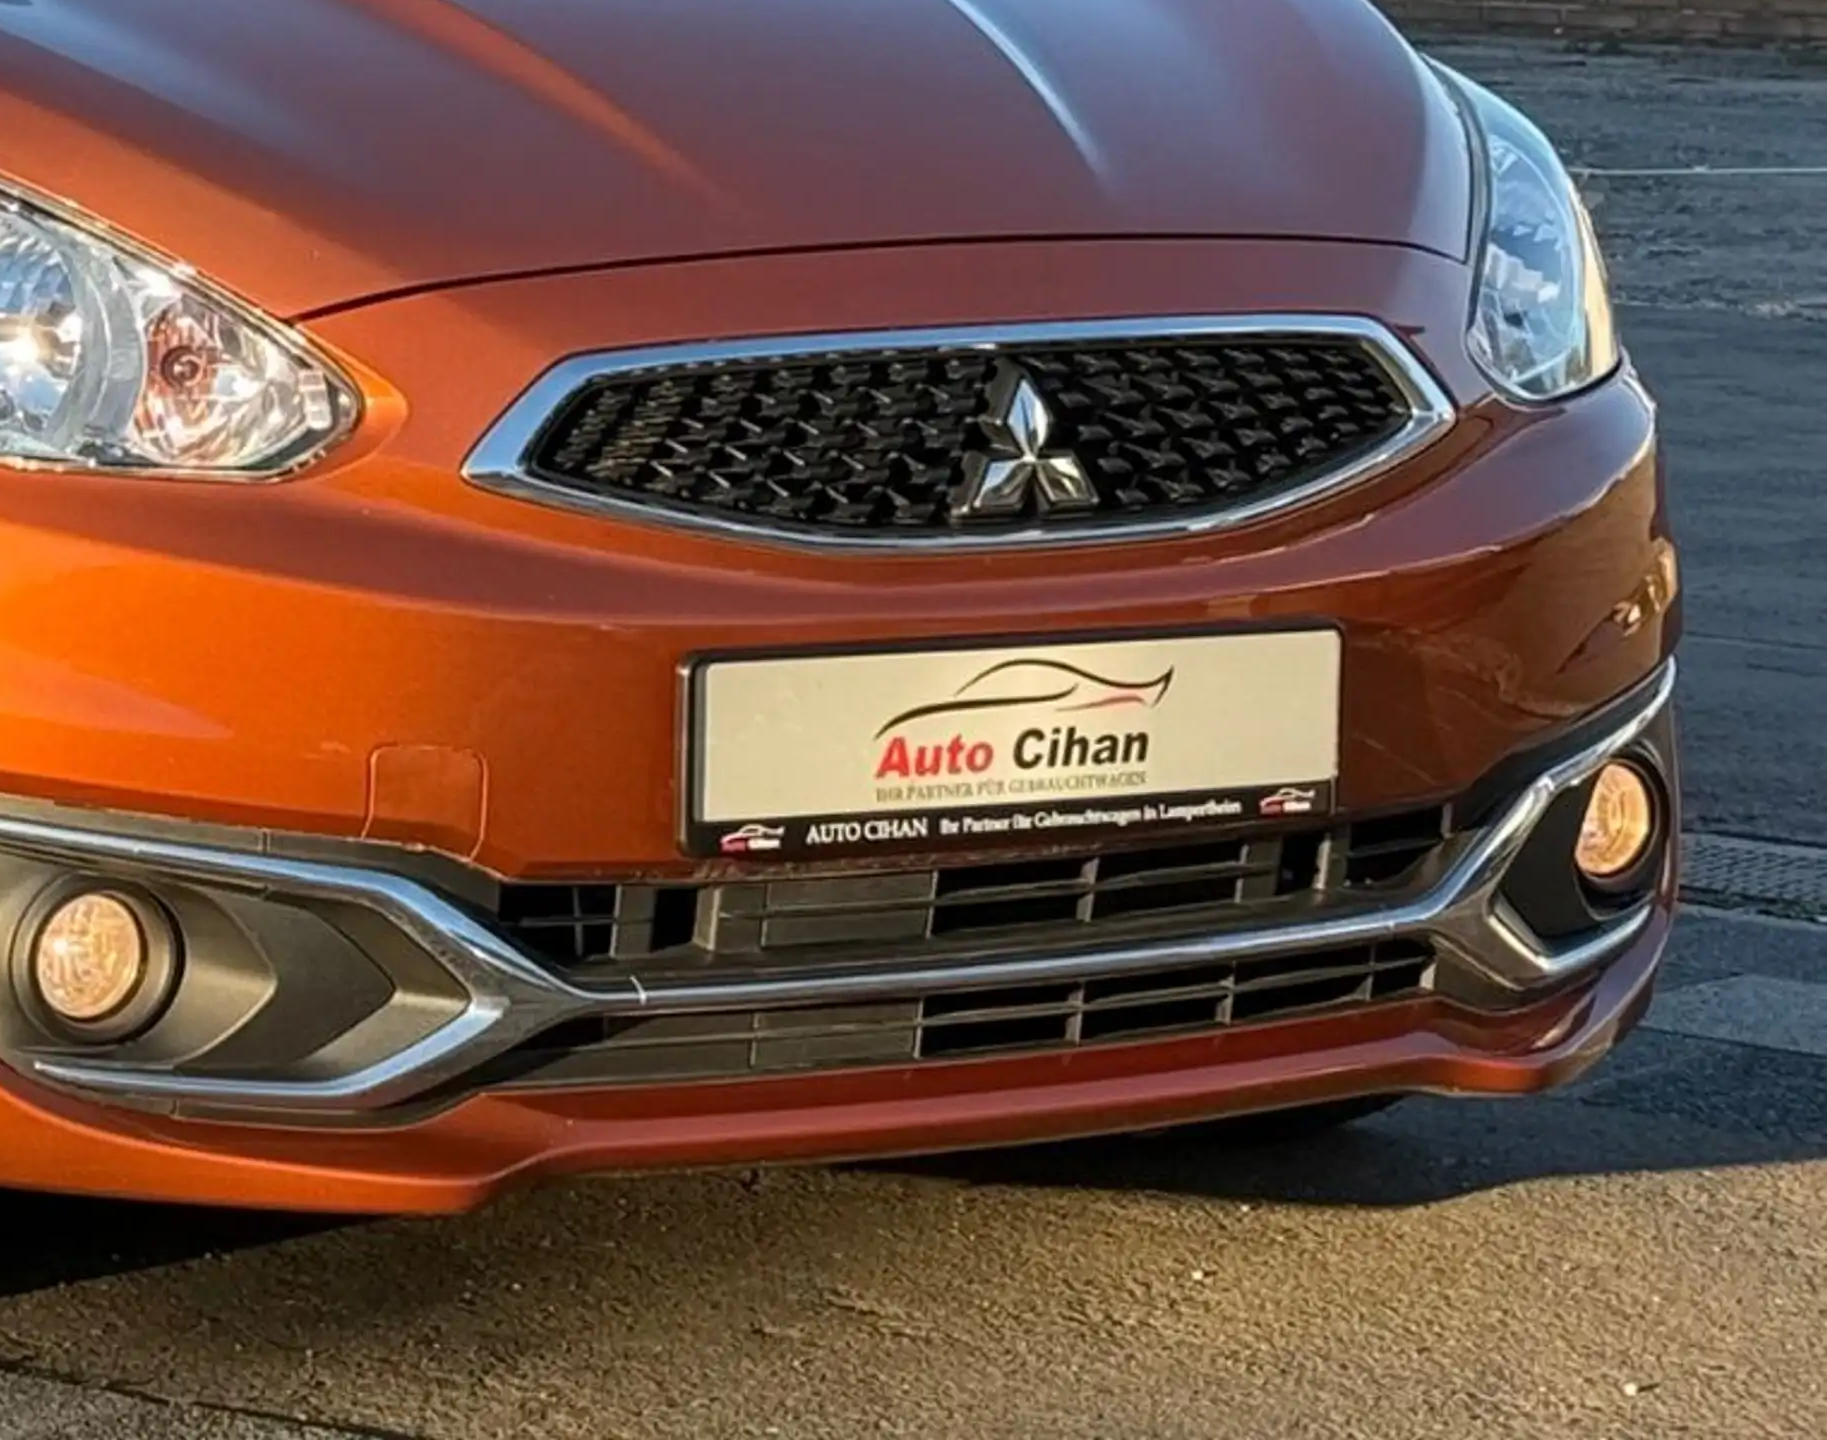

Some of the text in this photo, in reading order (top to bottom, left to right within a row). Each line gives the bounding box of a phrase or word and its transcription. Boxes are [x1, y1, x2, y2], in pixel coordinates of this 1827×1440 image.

[875, 726, 1149, 780] Auto Cihan
[907, 782, 973, 801] PARTNER
[805, 821, 861, 845] AUTO
[864, 817, 929, 839] CIHAN
[962, 816, 1011, 833] Partner
